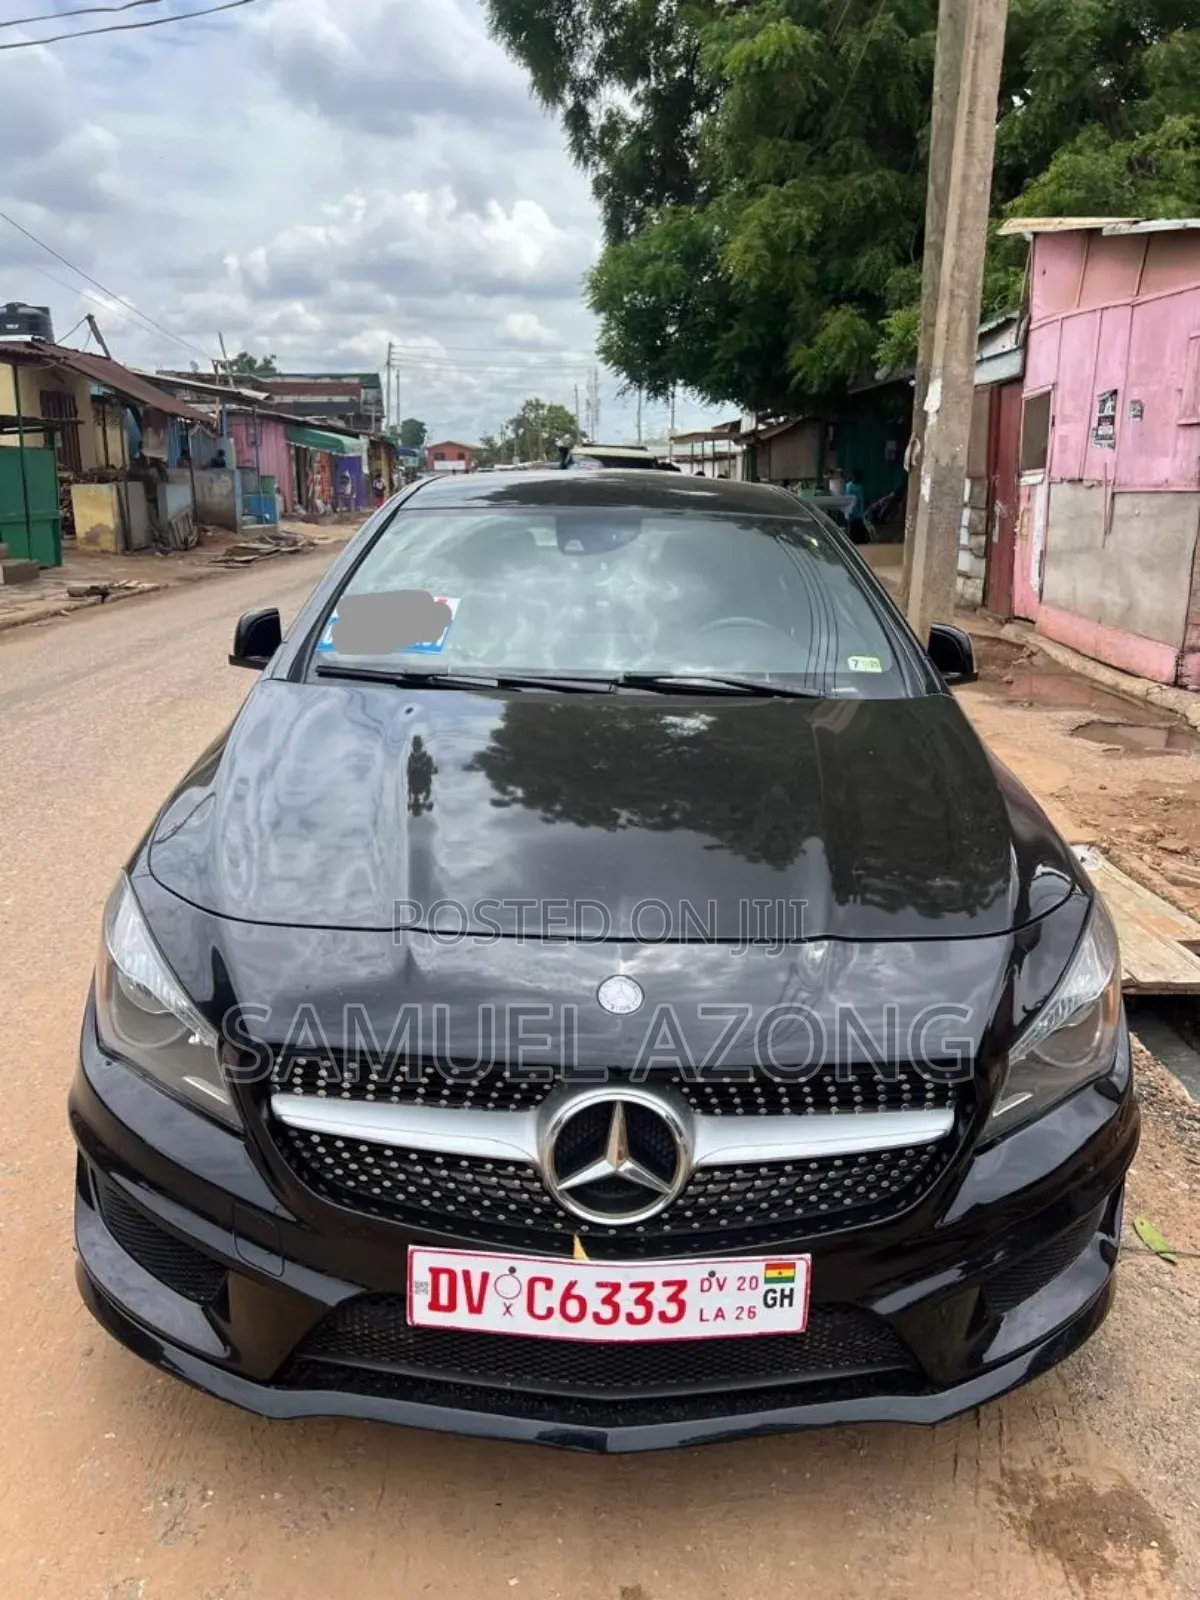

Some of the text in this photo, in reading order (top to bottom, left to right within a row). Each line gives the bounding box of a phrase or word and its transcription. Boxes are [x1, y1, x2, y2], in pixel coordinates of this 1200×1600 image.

[700, 1276, 759, 1293] DV 20
[427, 1266, 687, 1325] DV C6333
[763, 1288, 794, 1308] GH
[699, 1306, 757, 1322] LA 26
